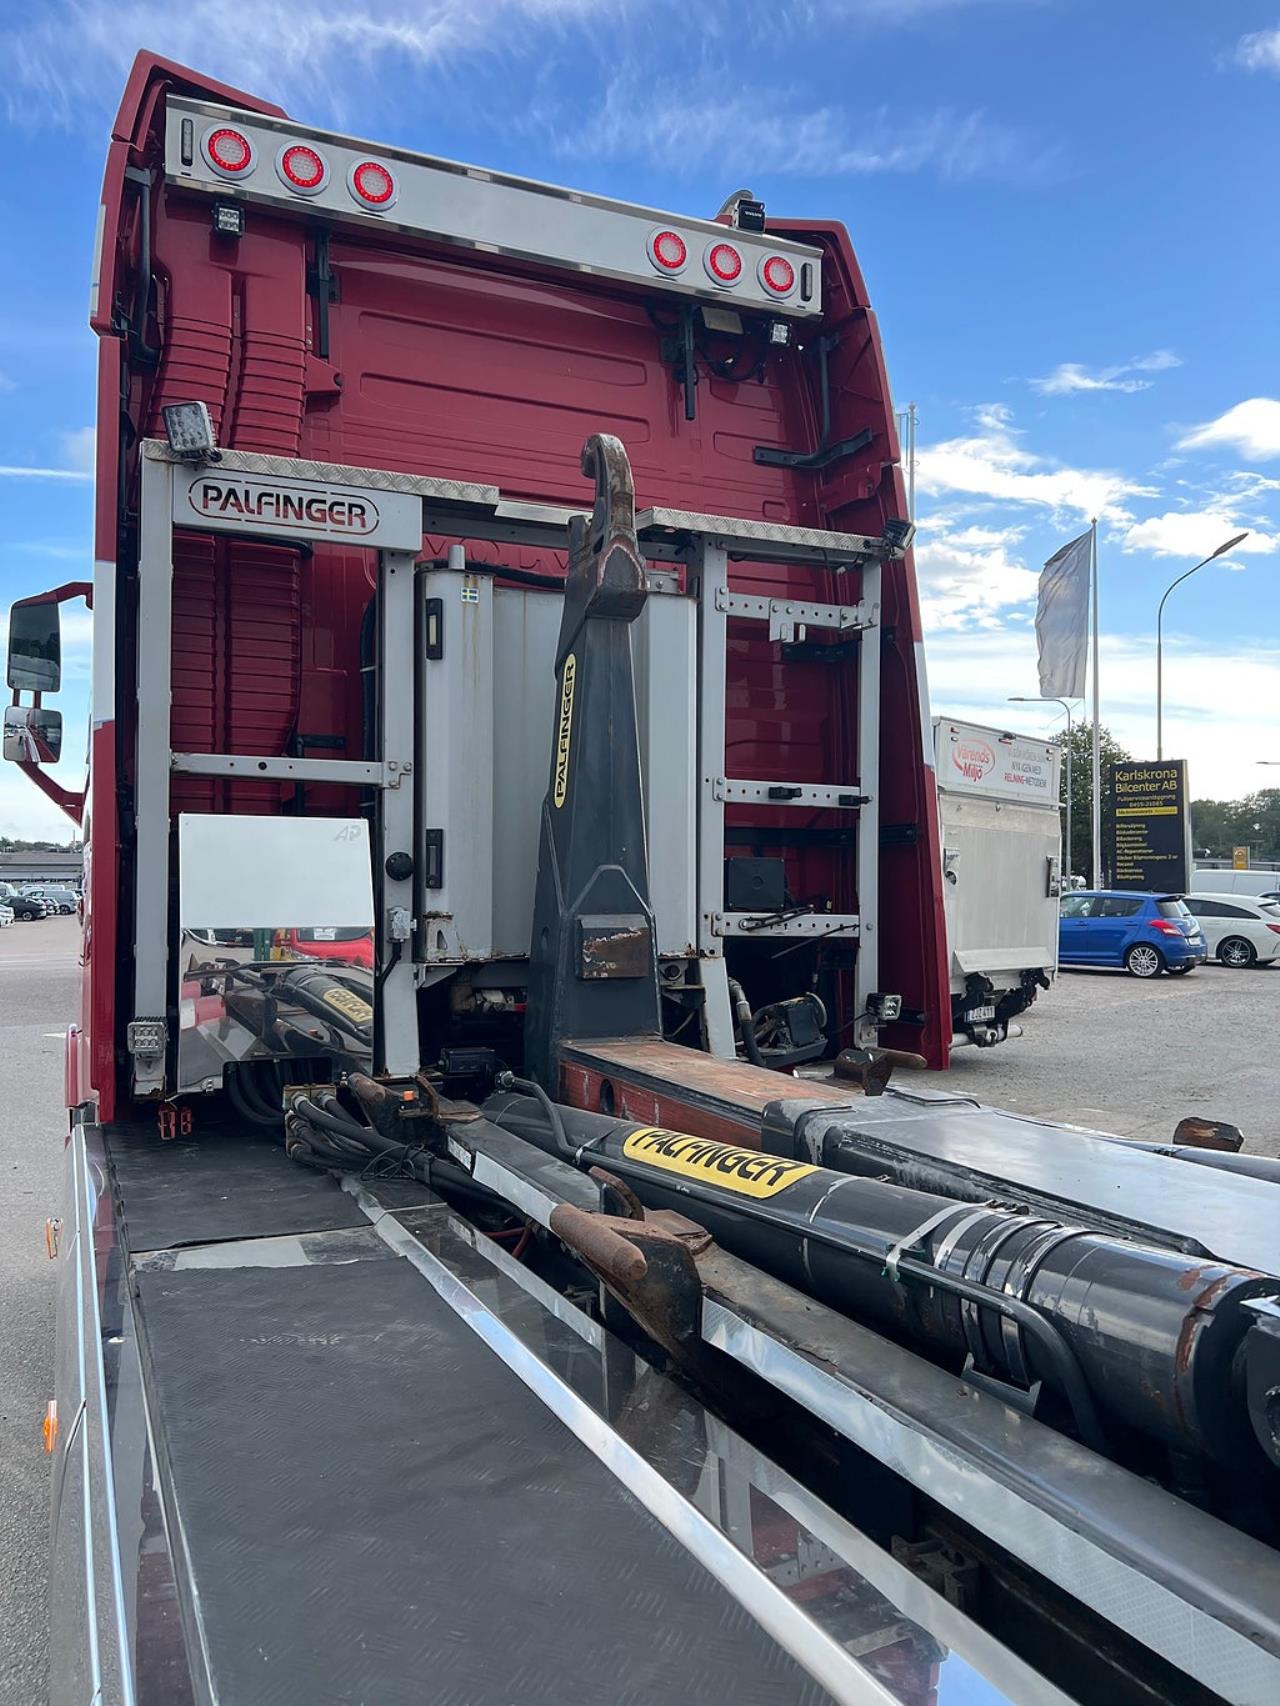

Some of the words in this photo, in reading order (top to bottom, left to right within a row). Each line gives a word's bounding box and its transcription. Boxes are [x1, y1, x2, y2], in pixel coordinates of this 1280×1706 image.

[202, 484, 367, 529] PALFINGER
[556, 663, 574, 798] PALFINGER
[1115, 769, 1177, 781] Karlskrona
[1115, 782, 1160, 793] Bilcenter
[1162, 781, 1178, 790] AB
[632, 1130, 805, 1187] PALFINGER
